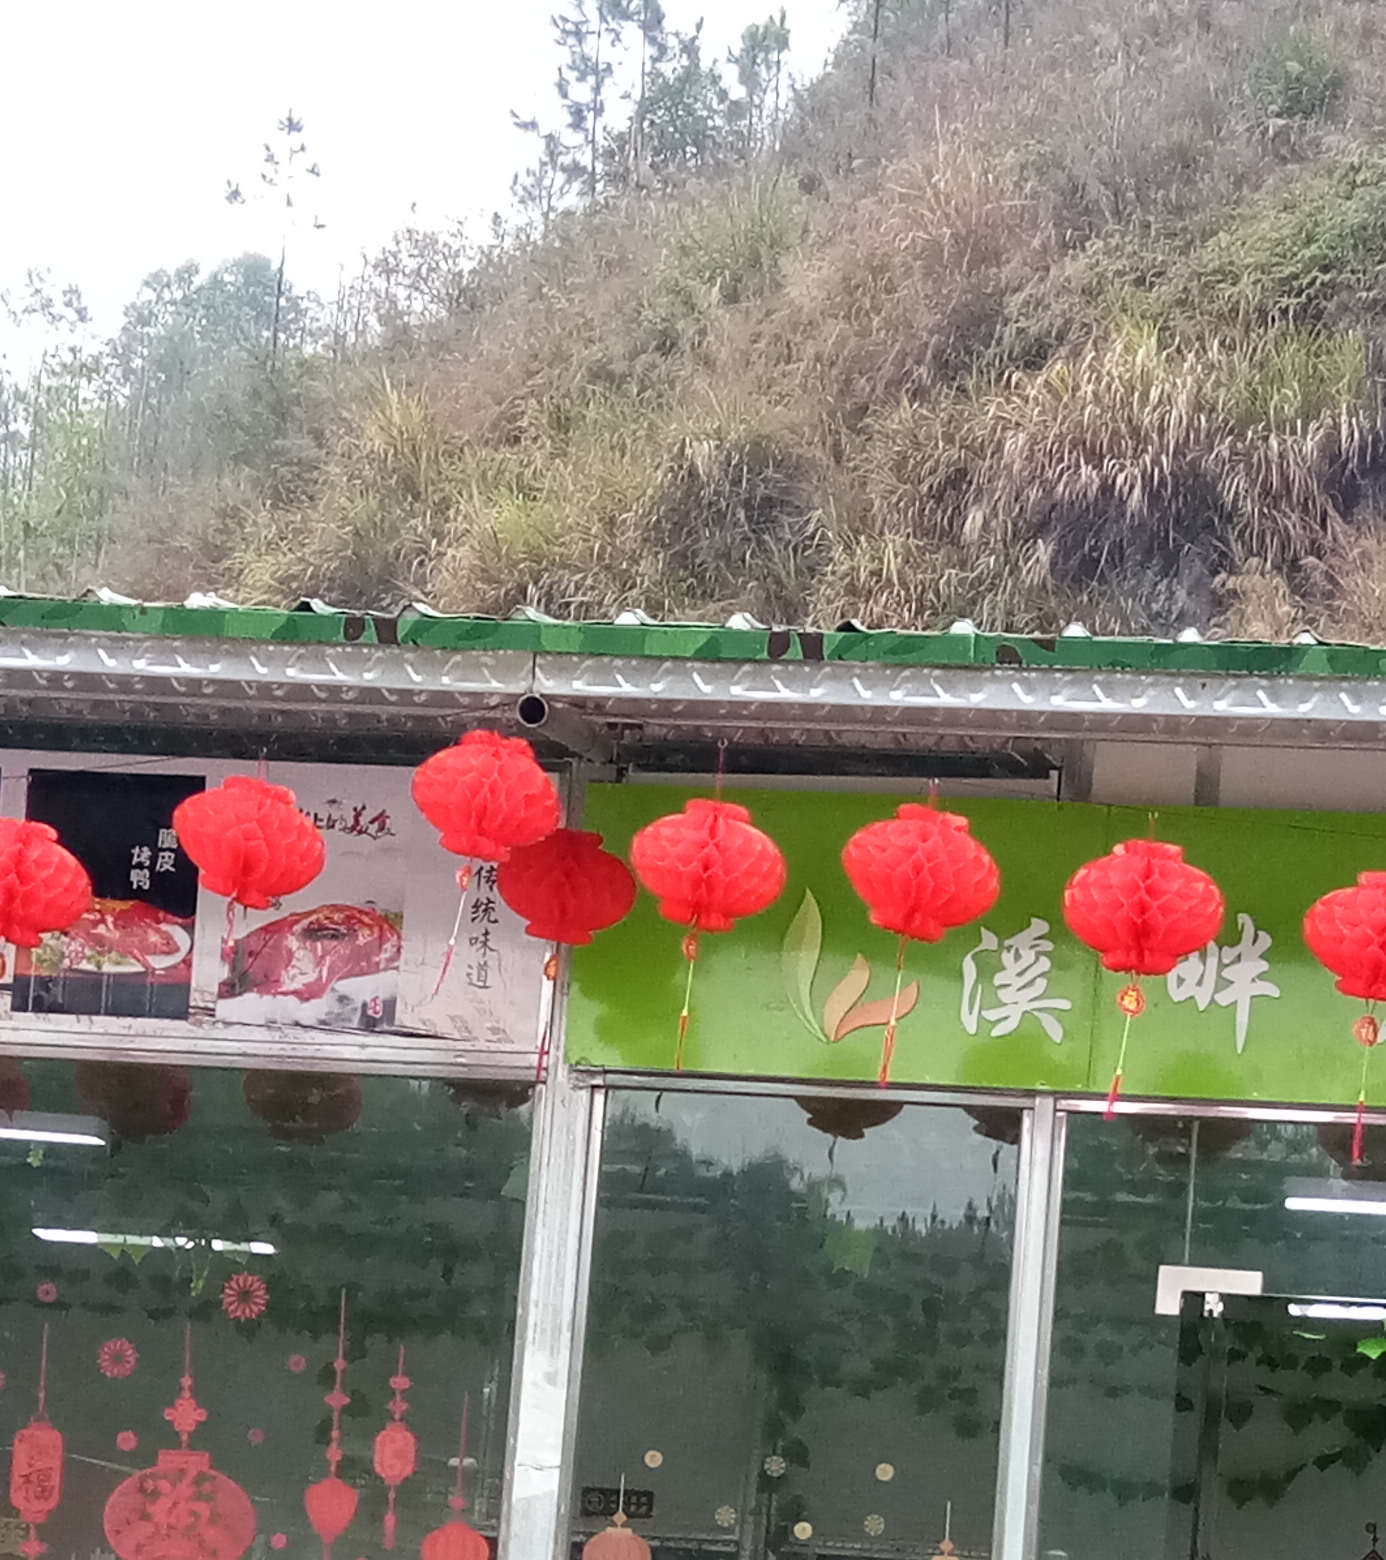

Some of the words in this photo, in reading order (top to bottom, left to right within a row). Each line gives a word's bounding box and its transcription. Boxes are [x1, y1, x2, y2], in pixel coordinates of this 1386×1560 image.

[299, 804, 397, 840] 上的美食
[130, 844, 152, 891] 烤鸭
[465, 864, 503, 990] 传统味道
